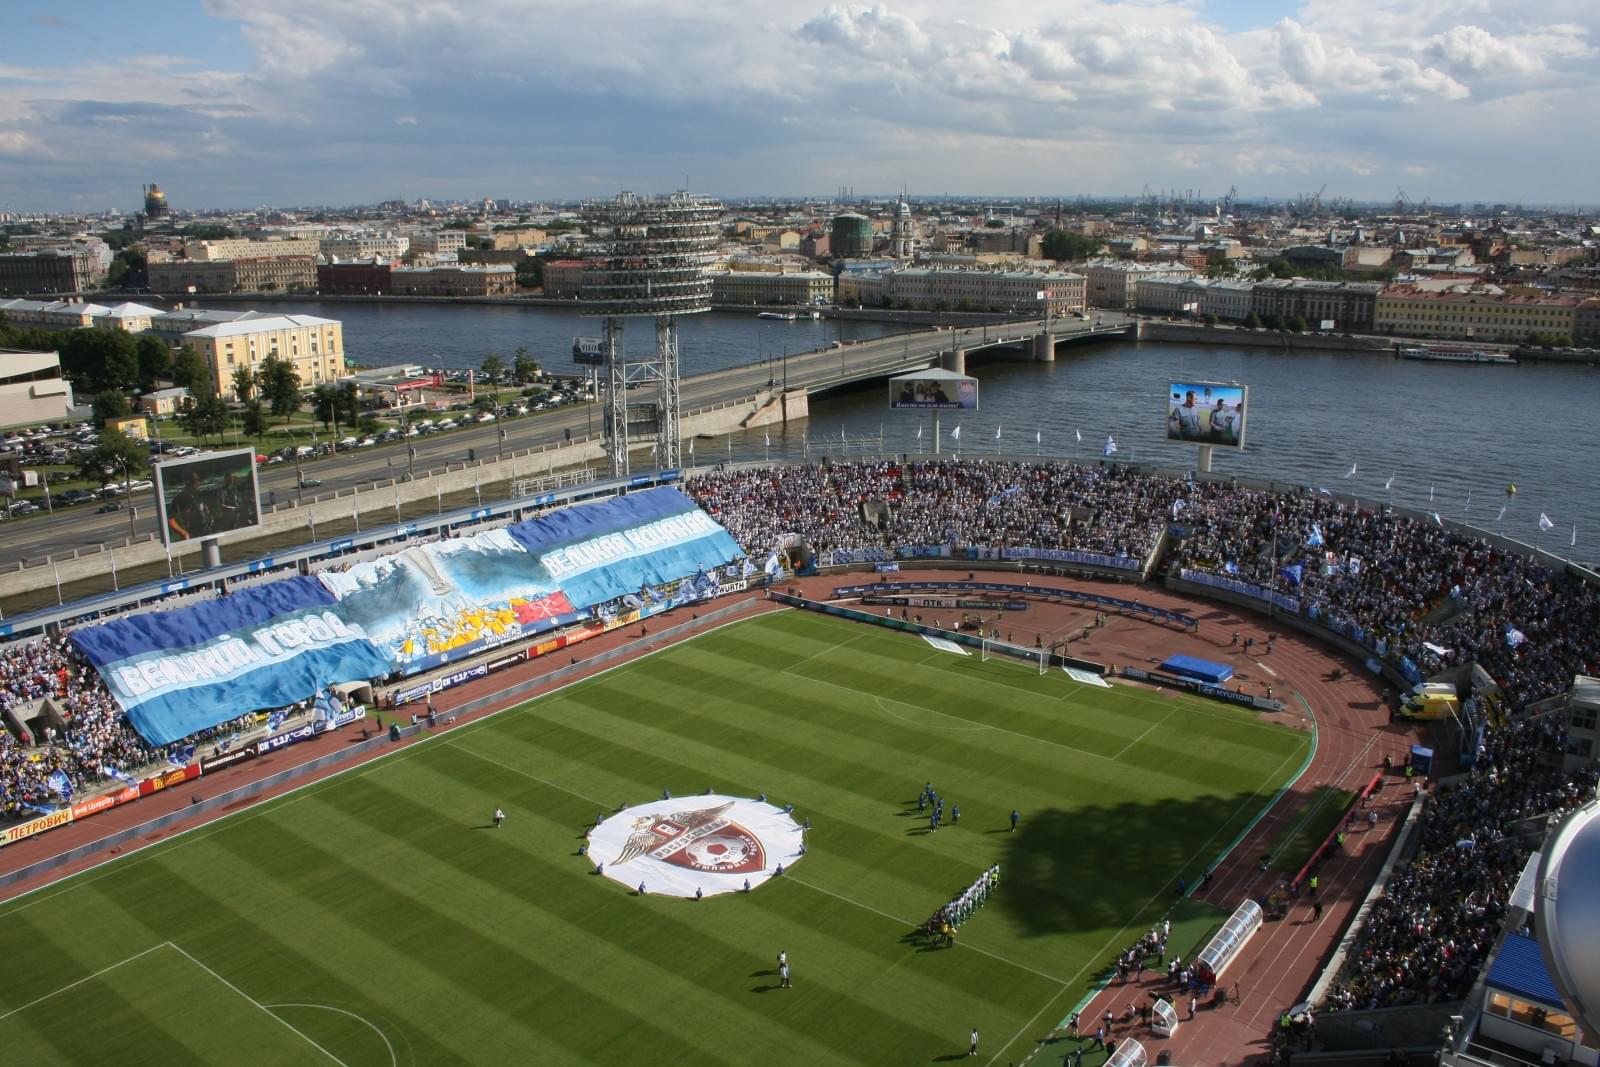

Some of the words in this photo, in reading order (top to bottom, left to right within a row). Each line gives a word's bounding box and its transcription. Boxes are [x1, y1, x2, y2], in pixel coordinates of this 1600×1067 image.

[485, 626, 523, 644] WINNERS
[112, 634, 259, 697] ВЕЛИКИЙ
[252, 611, 364, 657] ГОРОД
[1216, 689, 1250, 703] HYUNDAI
[8, 811, 69, 841] ПЕТРОВИЧ
